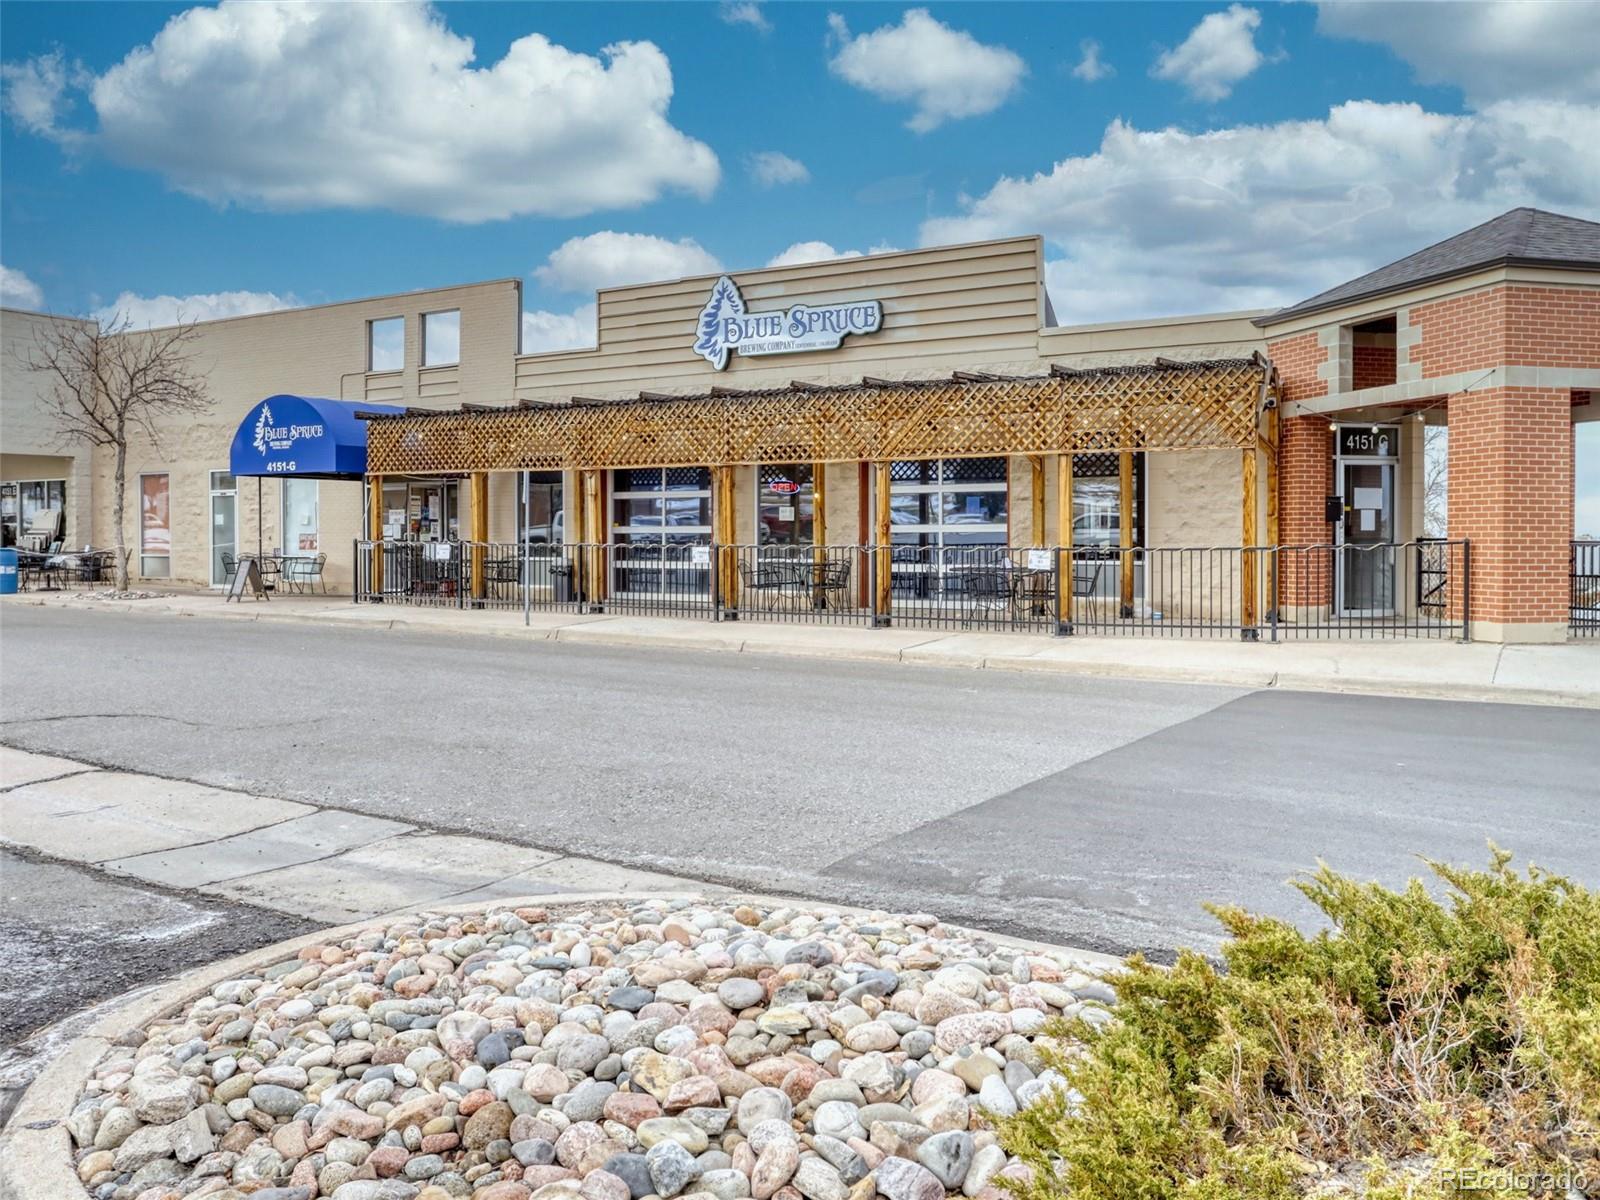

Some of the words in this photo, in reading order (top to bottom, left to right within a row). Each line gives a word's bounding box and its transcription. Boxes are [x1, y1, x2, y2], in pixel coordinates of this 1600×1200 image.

[722, 315, 783, 343] BLUE
[788, 305, 877, 338] SPRUCE
[740, 342, 767, 353] BREWING
[767, 340, 795, 352] COMPANY
[264, 426, 288, 441] BLUE
[289, 424, 323, 440] SPRUCE
[1347, 434, 1374, 450] 4151
[266, 461, 296, 472] 4151-G
[771, 482, 797, 492] OPEN
